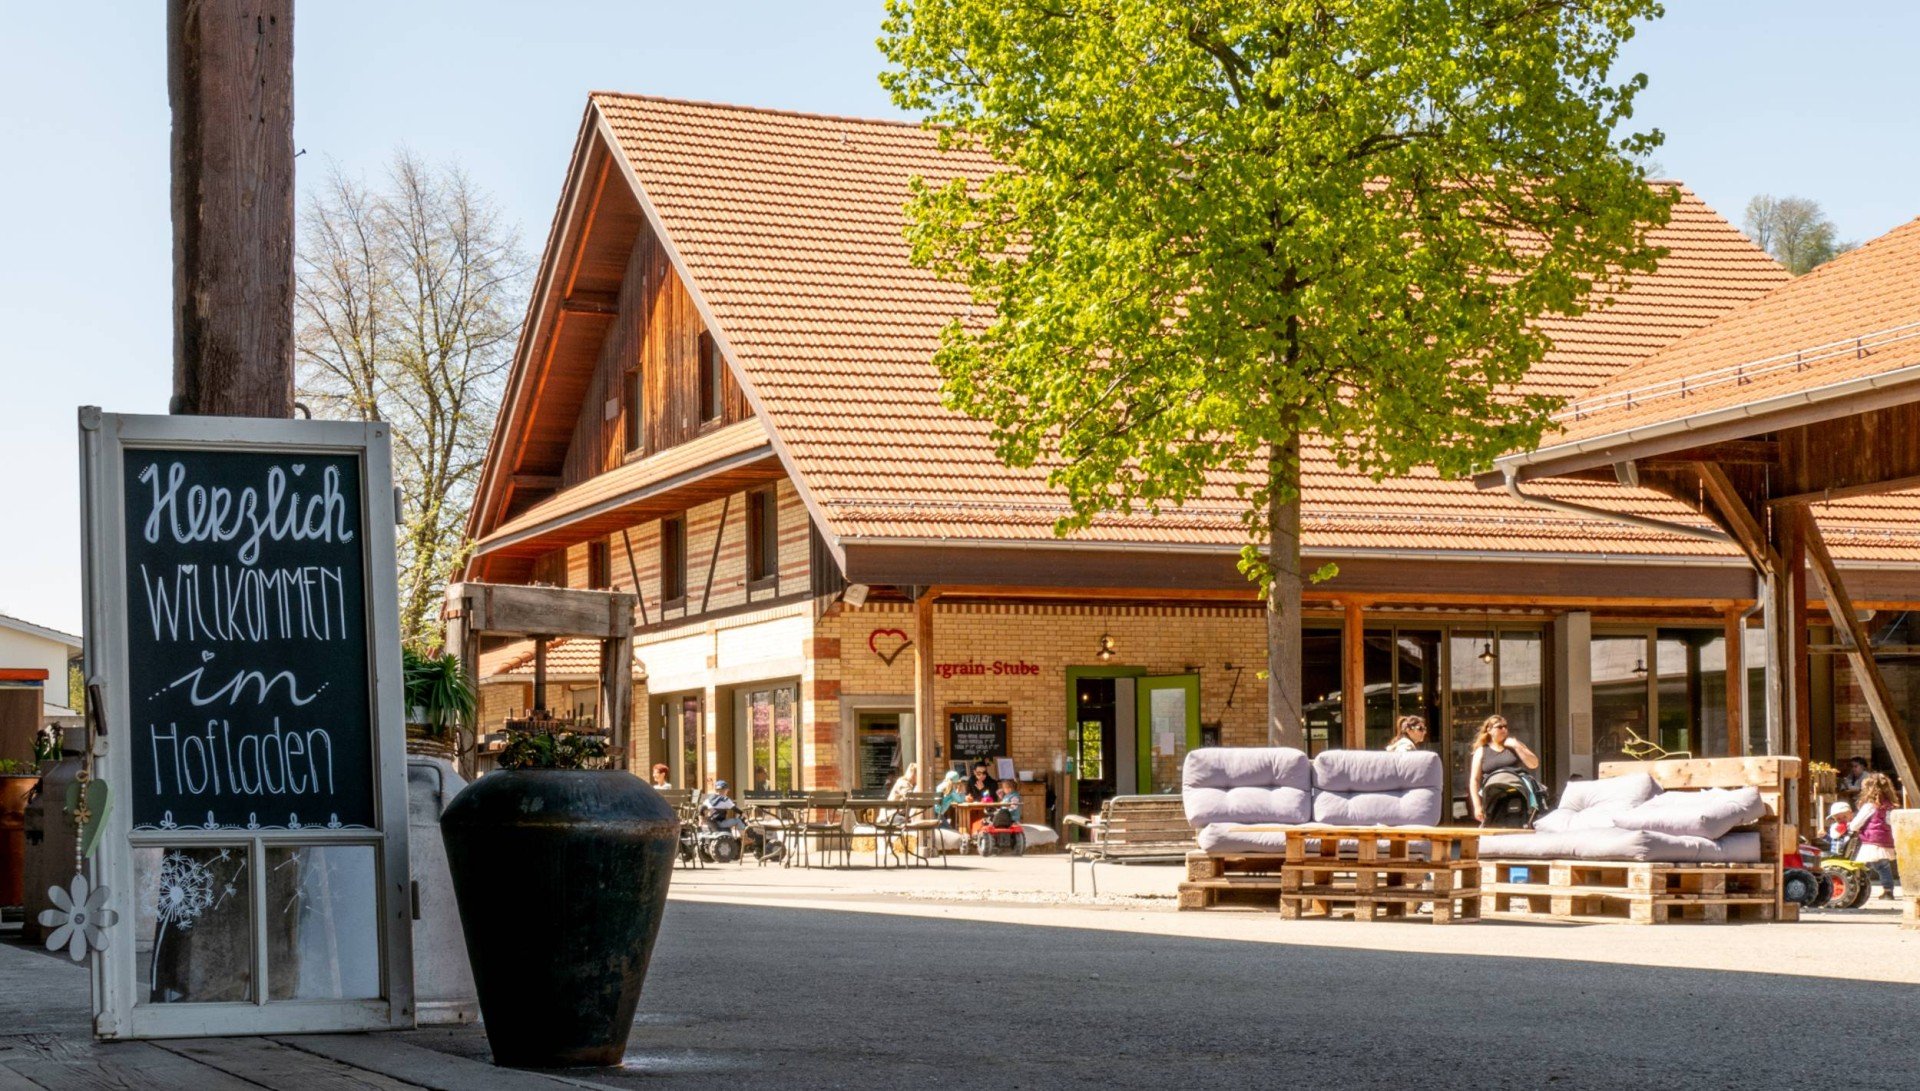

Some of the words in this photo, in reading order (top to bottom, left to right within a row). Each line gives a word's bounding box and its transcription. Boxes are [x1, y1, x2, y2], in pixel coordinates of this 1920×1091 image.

[139, 461, 354, 566] Herzlich
[169, 650, 318, 706] im
[934, 659, 1040, 679] rgrain-Stube
[150, 716, 335, 795] Hofladen
